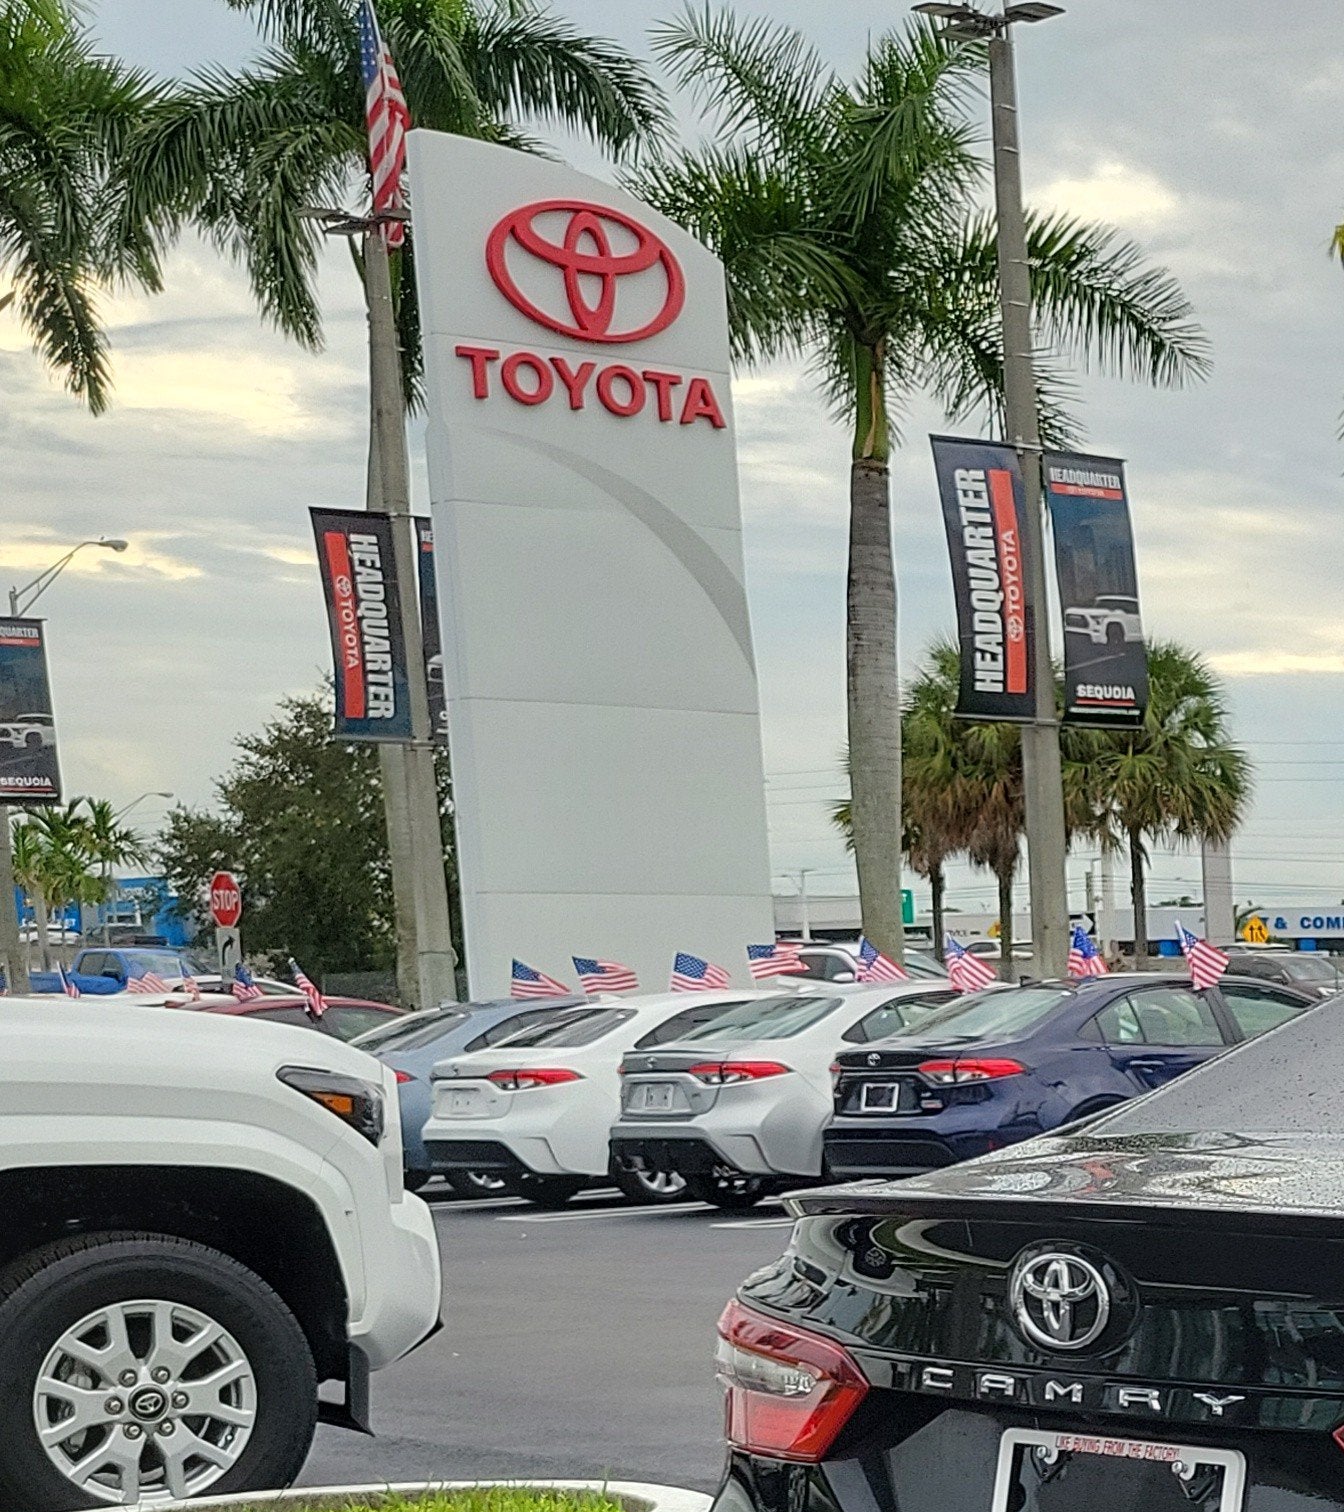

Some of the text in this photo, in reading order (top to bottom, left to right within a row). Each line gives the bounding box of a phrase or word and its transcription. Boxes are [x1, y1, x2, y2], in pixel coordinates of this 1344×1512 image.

[455, 345, 727, 429] TOYOTA
[954, 468, 1004, 693] HEADQUARTER
[1002, 529, 1018, 611] TOYOTA
[340, 599, 359, 669] TOYOTA
[350, 533, 395, 720] HEADQUARTER
[1076, 683, 1136, 700] SEQUOIA
[0, 776, 53, 787] SEQUOIA
[212, 889, 239, 911] STOP
[922, 1367, 1246, 1417] CAMRY
